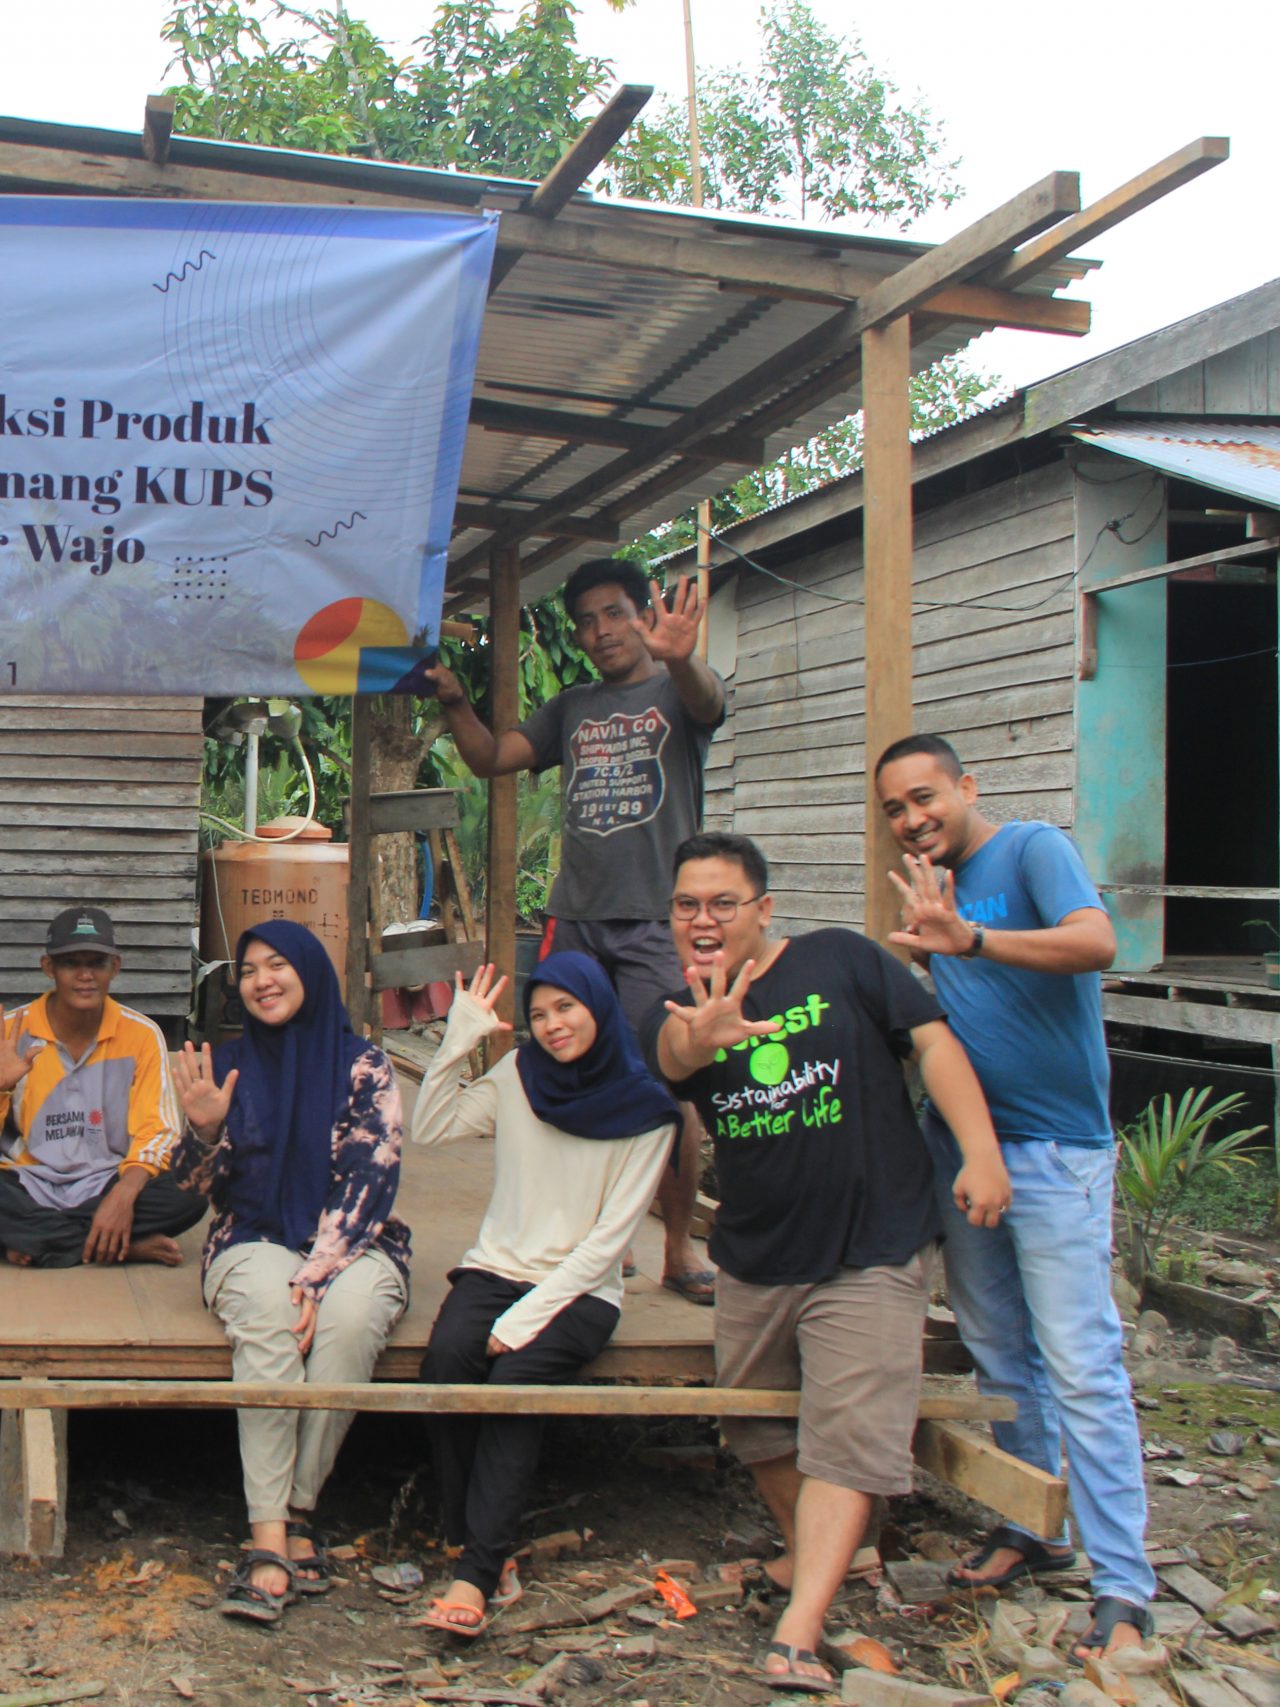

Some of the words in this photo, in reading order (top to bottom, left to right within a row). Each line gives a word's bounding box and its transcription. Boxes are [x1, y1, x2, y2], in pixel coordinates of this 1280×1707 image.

[81, 399, 271, 445] Produk
[135, 466, 274, 507] KUPS
[21, 523, 147, 577] Wajo
[578, 724, 627, 743] NAVAL
[632, 719, 658, 734] CO
[608, 774, 648, 786] SUPPORT
[612, 784, 653, 797] HARBOR
[579, 803, 598, 818] 19
[617, 801, 643, 815] 89
[727, 1110, 796, 1138] Better
[801, 1085, 842, 1128] Life
